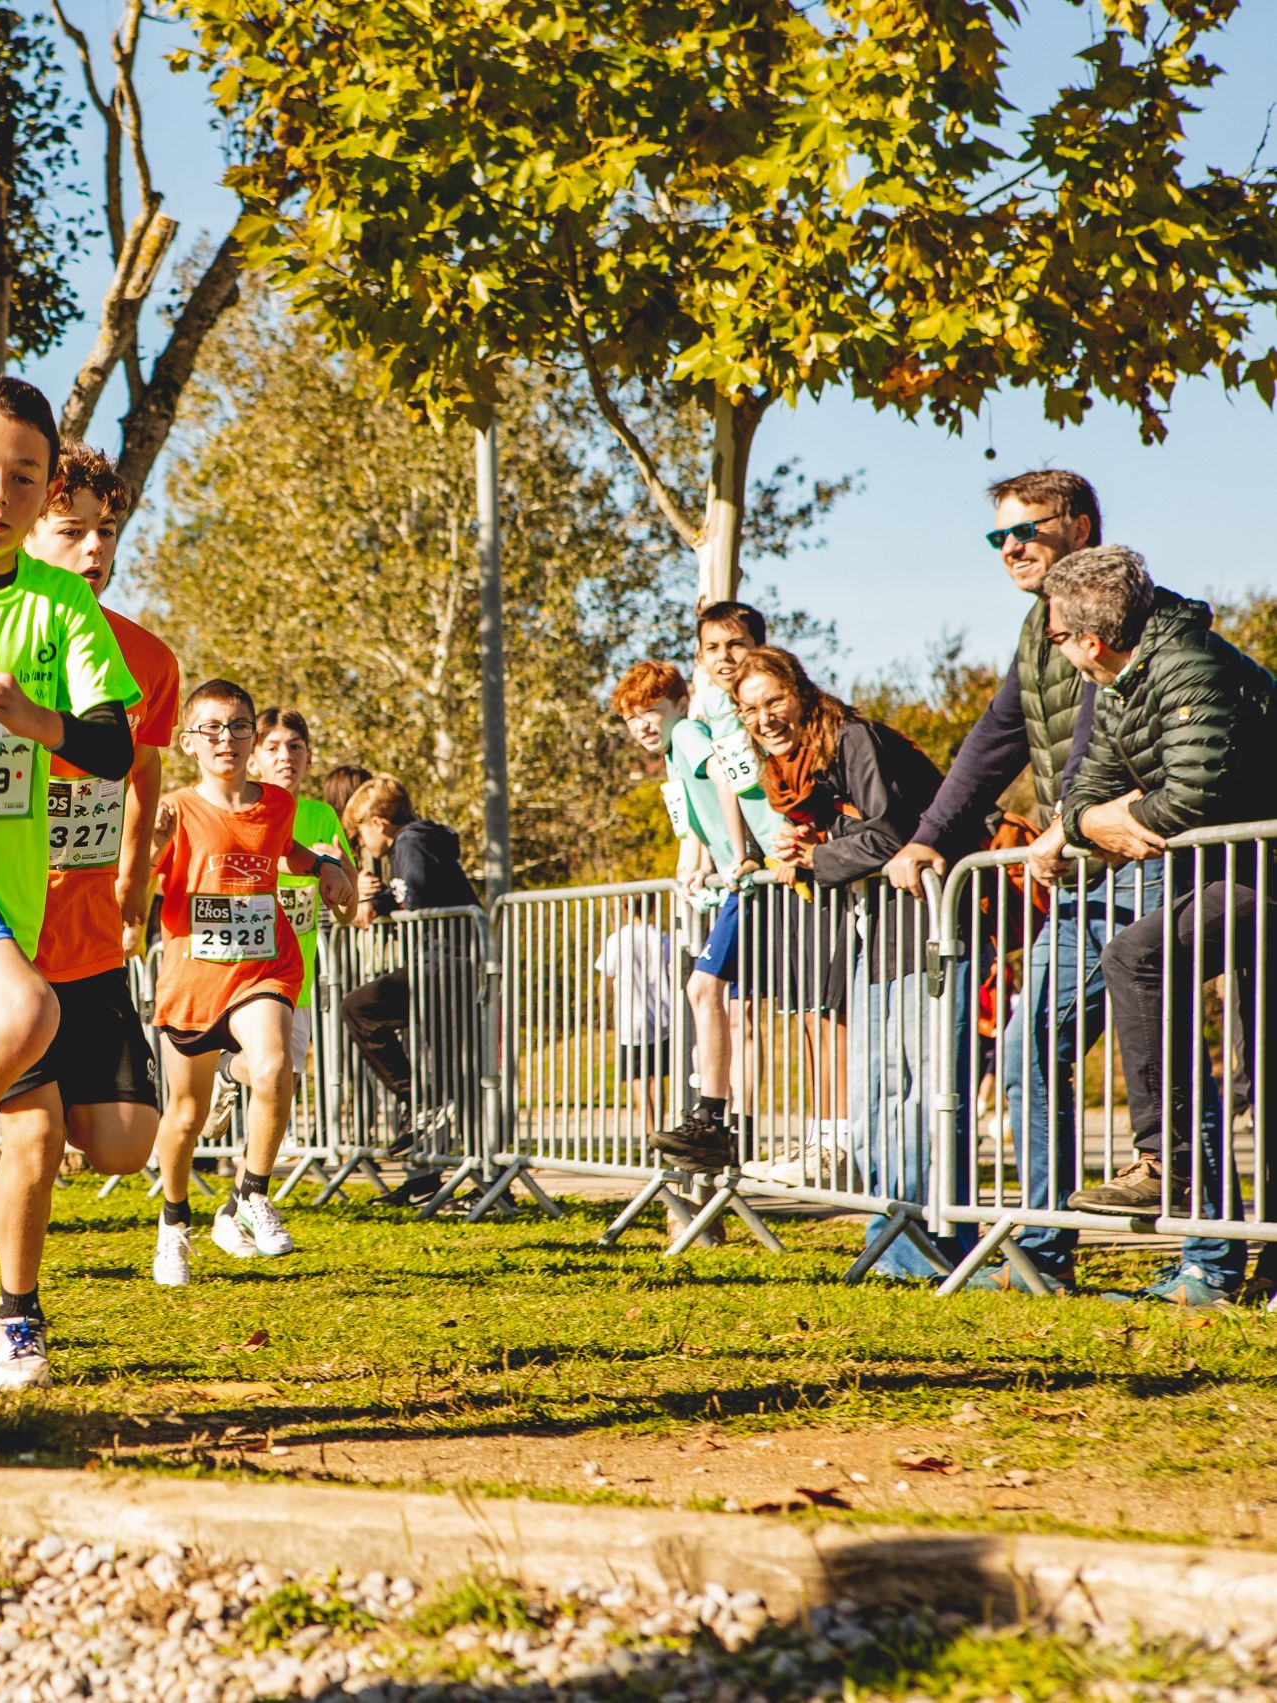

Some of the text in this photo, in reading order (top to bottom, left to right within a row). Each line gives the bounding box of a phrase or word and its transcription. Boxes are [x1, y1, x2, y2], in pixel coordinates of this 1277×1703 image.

[49, 797, 68, 810] OS
[49, 823, 108, 850] 327
[197, 908, 229, 919] CROS
[202, 928, 265, 946] 2928
